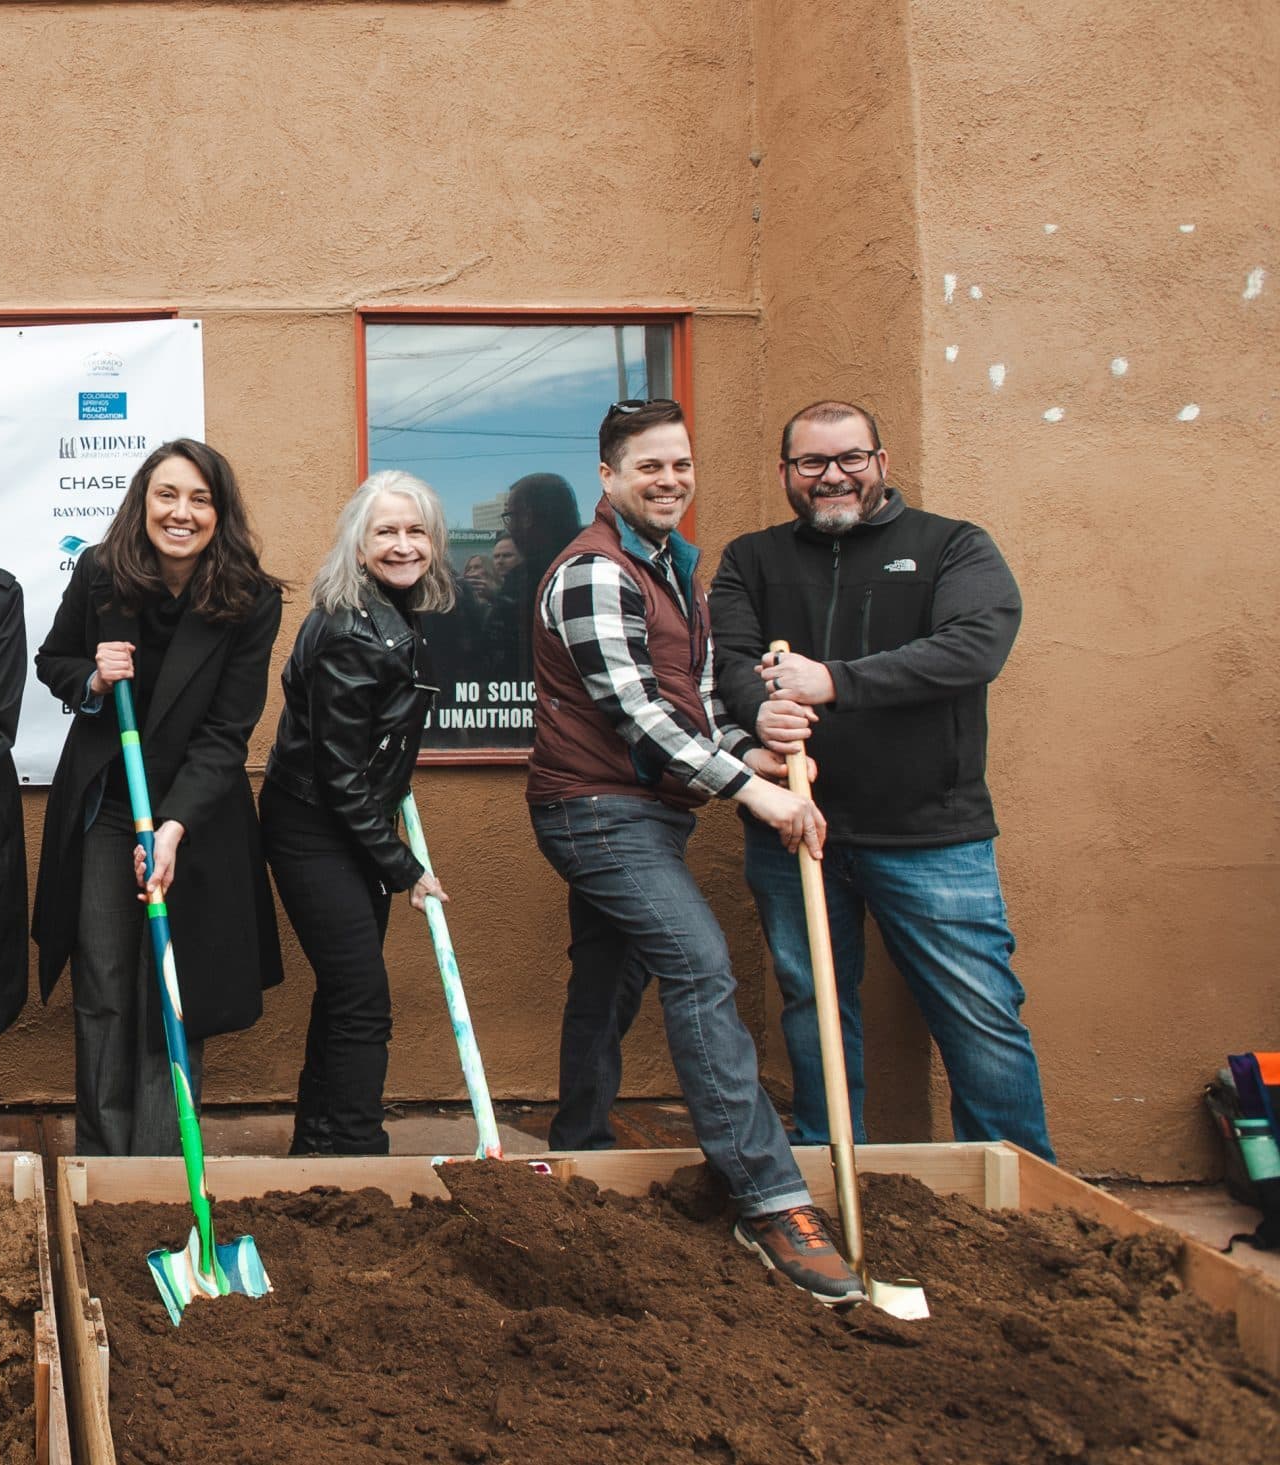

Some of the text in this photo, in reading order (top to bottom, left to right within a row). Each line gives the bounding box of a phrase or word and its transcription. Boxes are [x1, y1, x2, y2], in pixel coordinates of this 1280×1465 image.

[80, 435, 147, 450] WEIDNER
[60, 476, 127, 489] CHASE
[53, 506, 116, 517] RAYMOND
[455, 682, 479, 702] NO
[439, 708, 537, 729] UNAUTHOR
